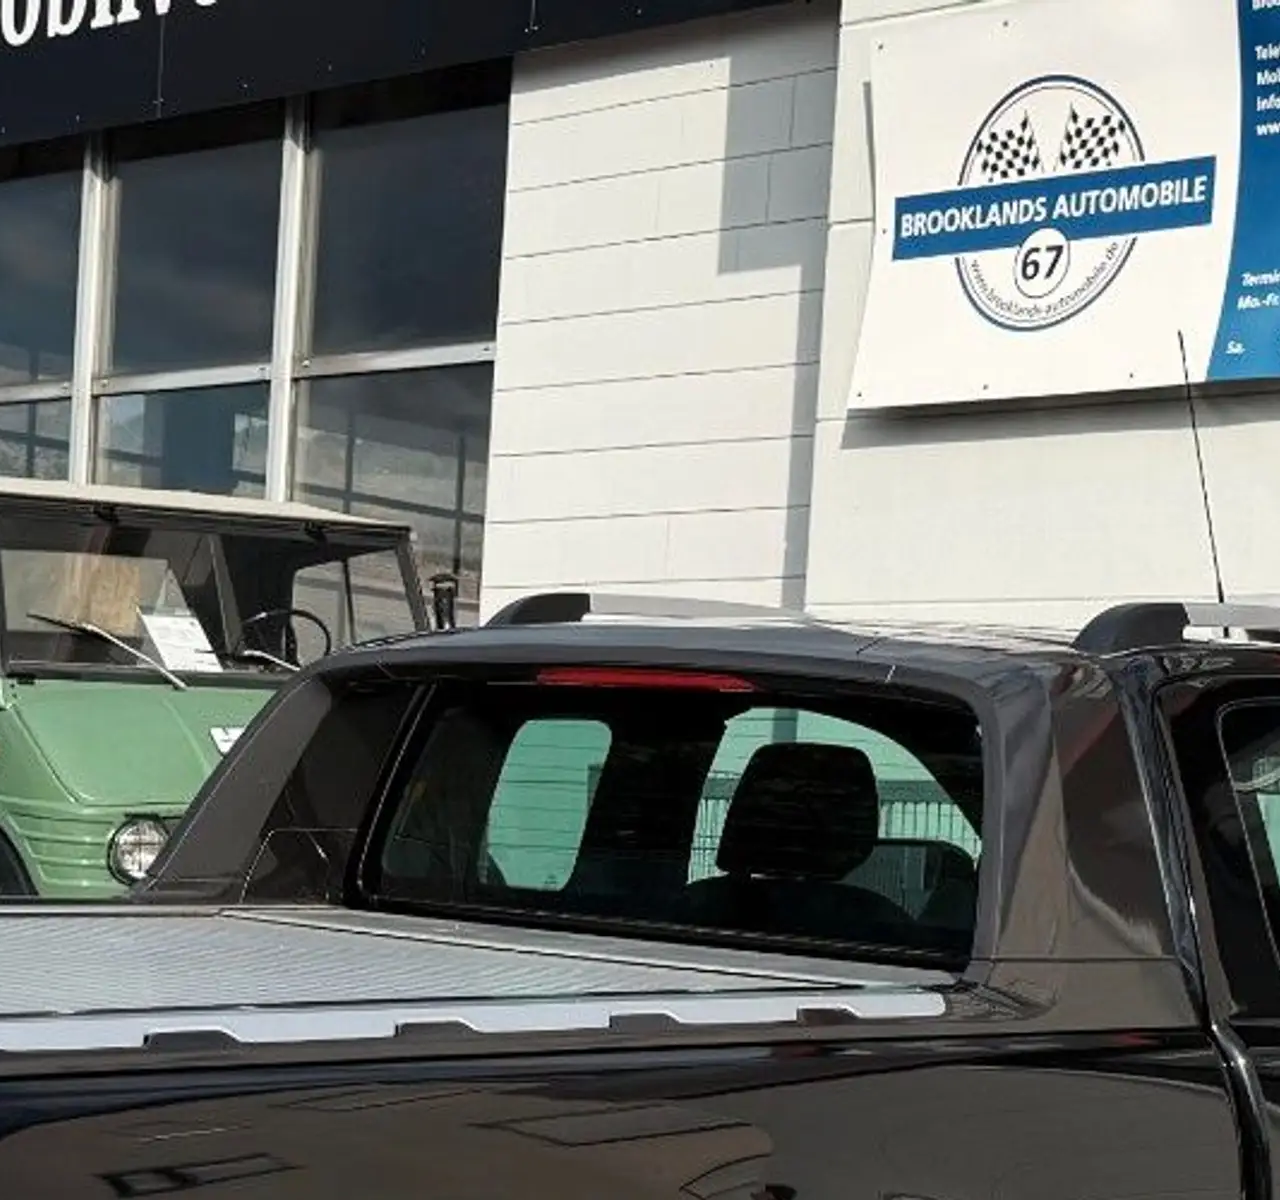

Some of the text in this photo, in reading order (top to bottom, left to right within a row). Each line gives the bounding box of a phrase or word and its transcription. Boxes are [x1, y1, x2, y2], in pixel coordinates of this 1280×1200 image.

[900, 175, 1209, 238] BROOKLANDS AUTOMOBILE
[1021, 245, 1065, 281] 67
